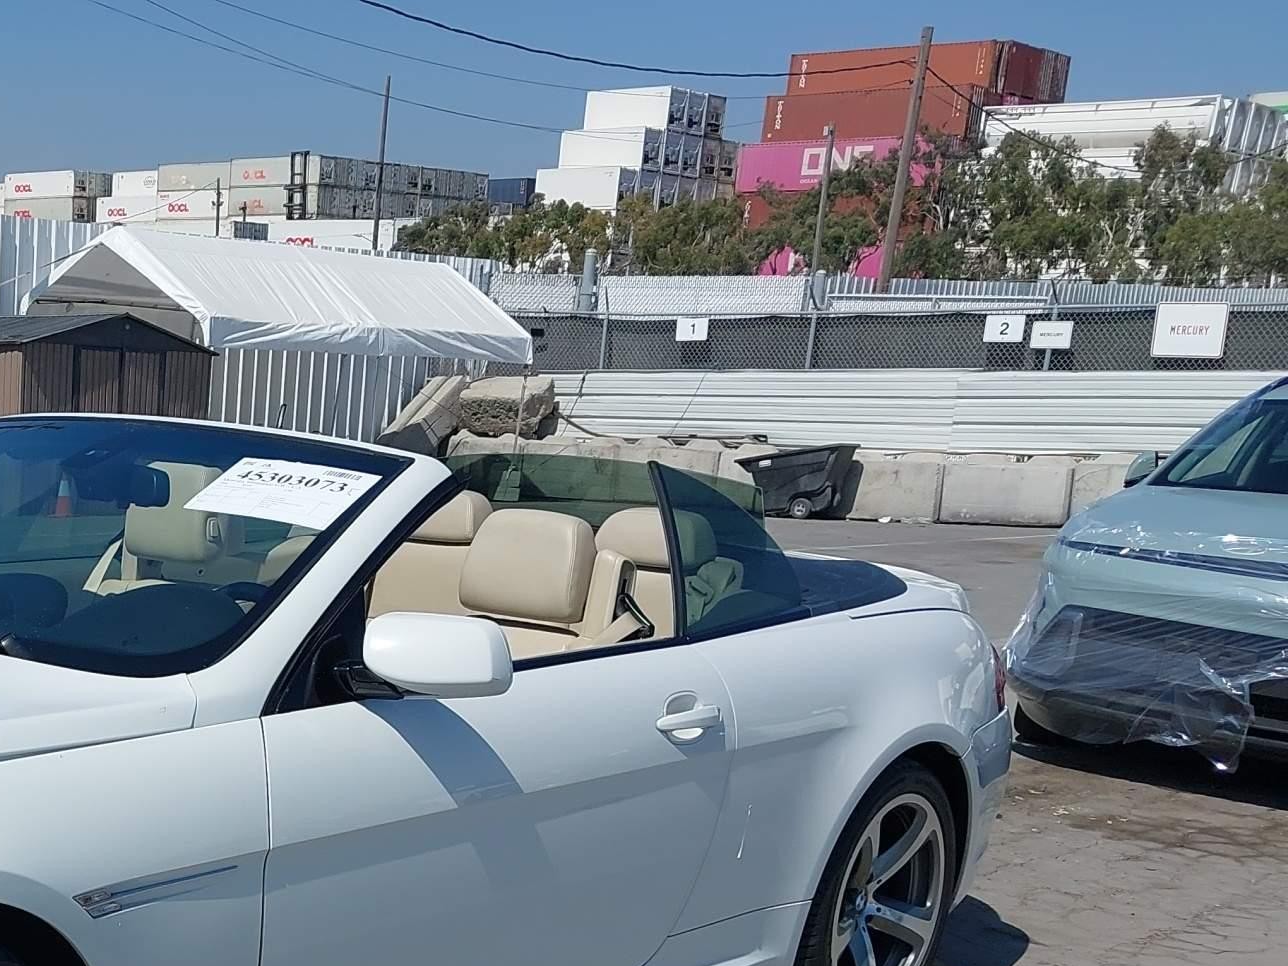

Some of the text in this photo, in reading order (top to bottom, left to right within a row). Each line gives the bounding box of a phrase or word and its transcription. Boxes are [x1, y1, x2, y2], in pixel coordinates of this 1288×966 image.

[243, 170, 266, 179] OCL
[14, 184, 32, 192] OOCL
[107, 208, 127, 216] OOCL
[168, 203, 189, 212] OOCL
[691, 323, 696, 335] 1
[999, 322, 1010, 335] 2
[1170, 325, 1210, 336] MERCURY
[237, 470, 349, 493] 45303073
